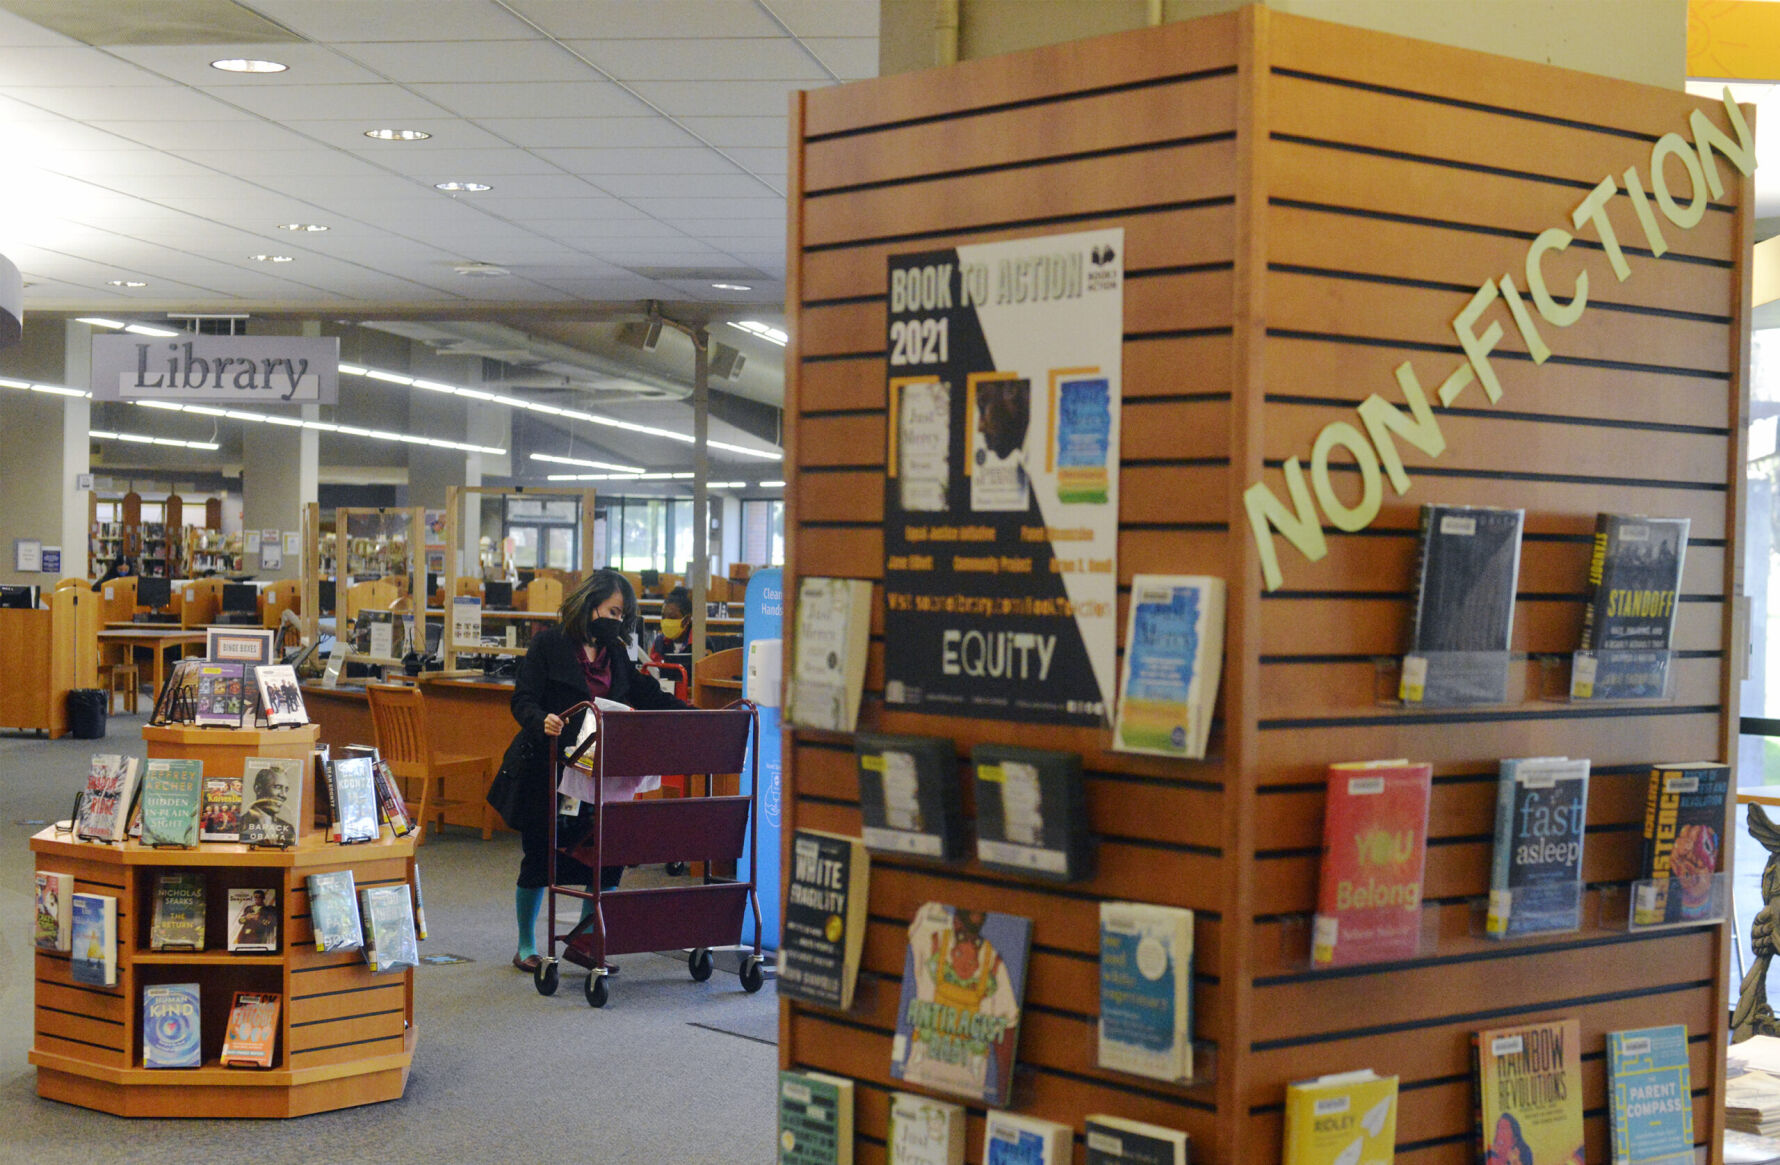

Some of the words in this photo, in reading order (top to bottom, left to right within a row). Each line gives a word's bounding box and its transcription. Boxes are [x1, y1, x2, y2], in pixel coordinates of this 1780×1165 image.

[891, 263, 953, 313] BOOK
[960, 261, 989, 308] TO
[996, 252, 1084, 305] ACTION
[890, 317, 949, 366] 2021
[1243, 84, 1758, 592] NON-FICTION
[134, 342, 308, 400] Library
[763, 587, 783, 600] Clean
[761, 603, 784, 616] Hands
[1607, 588, 1675, 618] STANDOFF
[146, 770, 196, 780] JEFFREY
[146, 781, 194, 791] ARCHER
[147, 797, 189, 807] HIDDEN
[1519, 792, 1583, 838] fast
[151, 819, 182, 828] SIGHT
[248, 823, 290, 832] BARACK
[250, 833, 287, 841] OBAMA
[1516, 837, 1579, 867] asleep
[158, 888, 203, 897] NICHOLAS
[1337, 878, 1420, 912] Belong
[165, 897, 194, 905] SPARKS
[170, 912, 186, 921] THE
[161, 921, 195, 929] RETURN
[150, 1003, 194, 1017] KIND
[1630, 1082, 1676, 1100] PARENT
[1627, 1098, 1682, 1118] COMPASS
